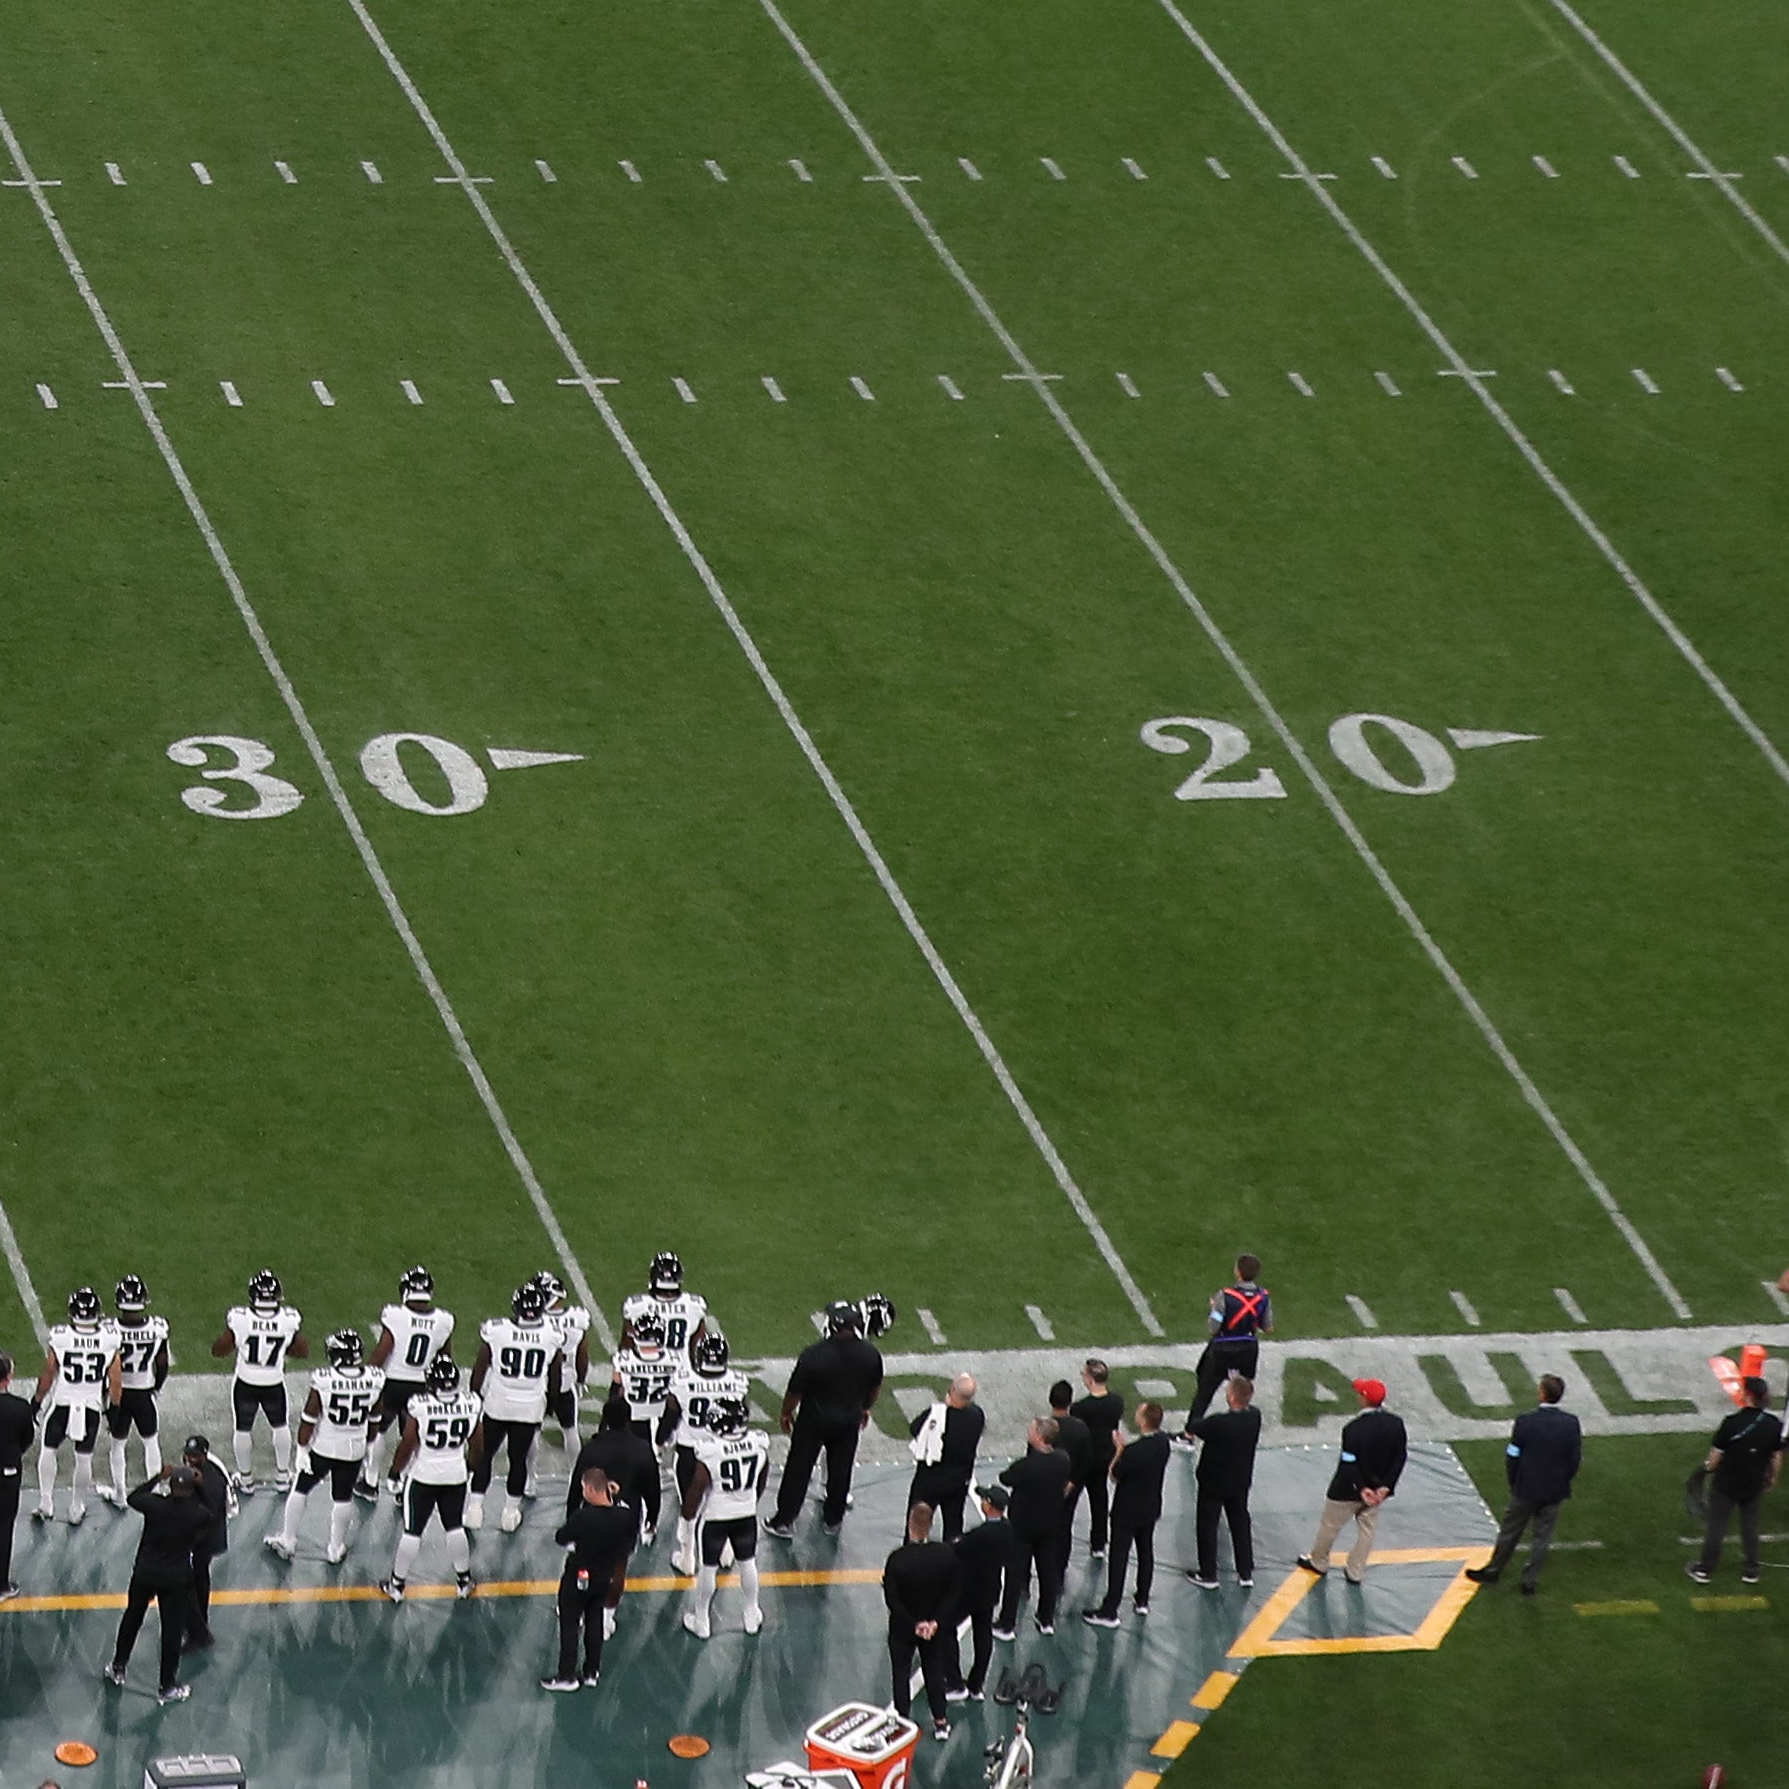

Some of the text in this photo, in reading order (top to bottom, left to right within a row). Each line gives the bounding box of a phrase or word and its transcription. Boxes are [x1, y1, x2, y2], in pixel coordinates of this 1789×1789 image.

[1139, 712, 1456, 800] 20
[165, 732, 488, 819] 30
[121, 1329, 158, 1342] TCHELL
[251, 1320, 279, 1333] DEAN
[511, 1330, 541, 1344] DAVIS
[73, 1337, 101, 1349] BAUN
[121, 1342, 155, 1373] 27
[243, 1336, 286, 1367] 17
[404, 1332, 430, 1367] 0
[62, 1351, 108, 1385] 53
[500, 1347, 546, 1379] 90
[331, 1379, 373, 1391] GRAHAM
[627, 1376, 671, 1404] 32
[688, 1382, 738, 1394] WILLIAMS
[1107, 1344, 1789, 1433] PAUL
[327, 1393, 371, 1426] 55
[425, 1418, 470, 1450] 59
[719, 1455, 759, 1492] 97
